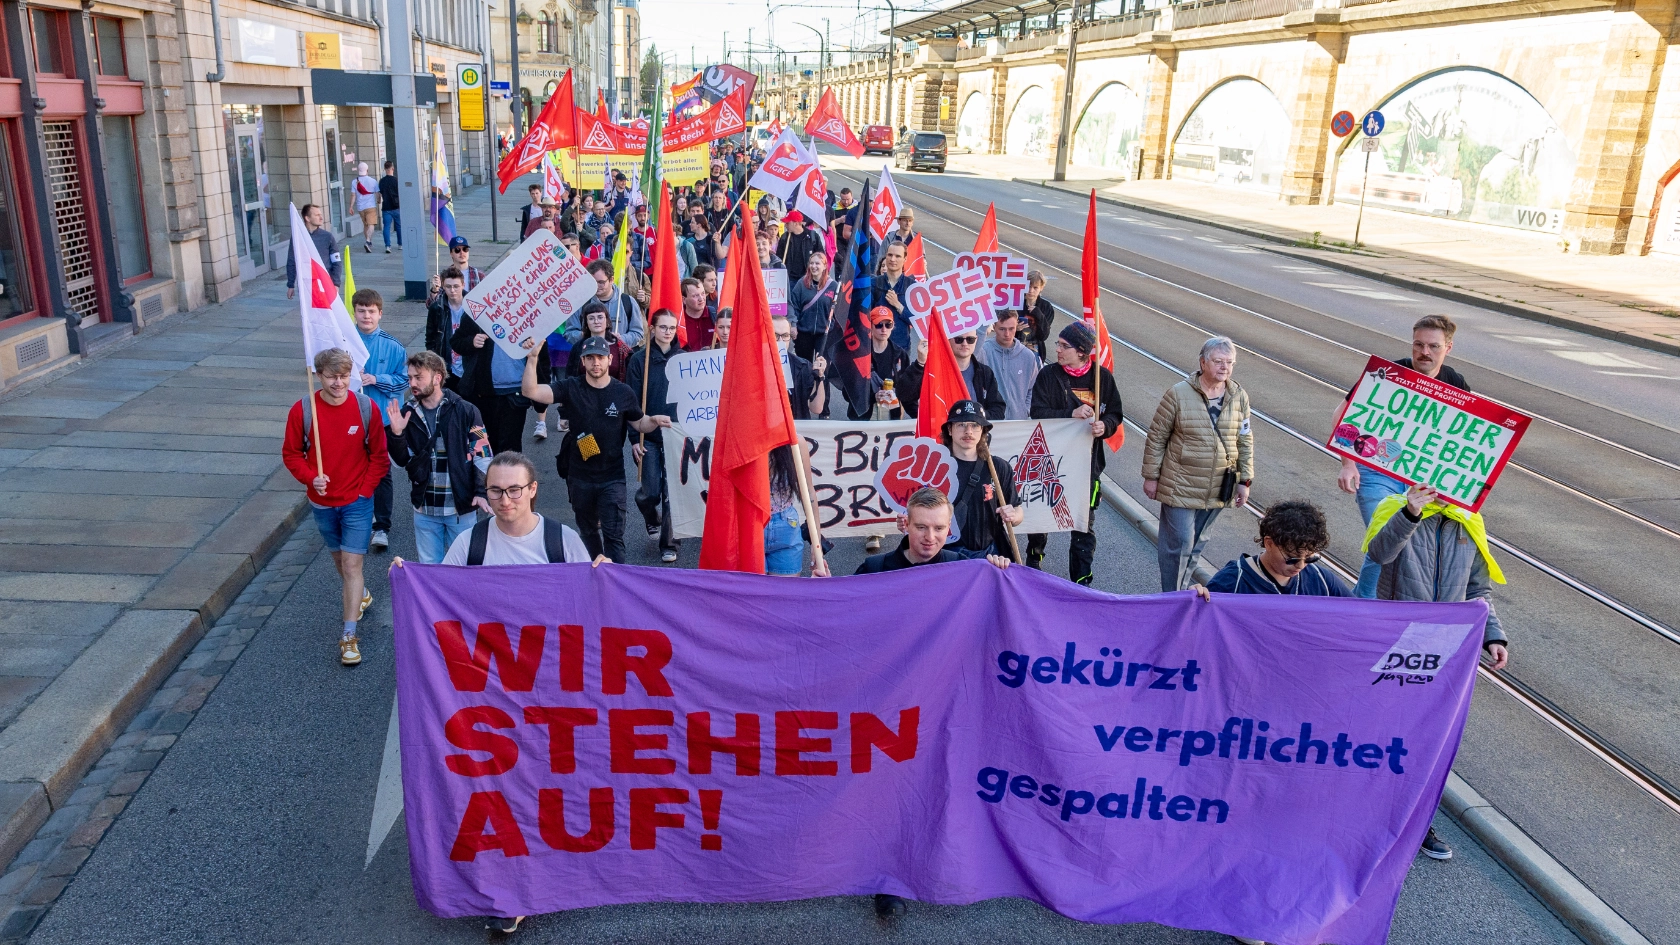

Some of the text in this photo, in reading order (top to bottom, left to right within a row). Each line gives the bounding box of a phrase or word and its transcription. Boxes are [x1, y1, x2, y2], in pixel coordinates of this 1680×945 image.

[680, 127, 705, 142] Recht
[769, 163, 793, 178] IGBCE
[1517, 209, 1547, 228] VVO
[520, 260, 534, 273] von
[531, 239, 554, 261] UNS
[485, 308, 504, 323] hat
[525, 255, 554, 285] einen
[503, 255, 576, 327] Bundeskanzler
[909, 272, 984, 313] OST=
[508, 308, 541, 344] ertragen
[678, 355, 727, 380] HÄN
[1395, 376, 1415, 388] STATT
[1416, 384, 1433, 395] EURE
[1416, 378, 1477, 403] UNSERE ZUKUNFT
[1343, 401, 1496, 477] ZUM LEBEN
[1446, 411, 1502, 449] DER
[1392, 449, 1492, 504] REICHT
[434, 619, 675, 697] WIR
[996, 642, 1201, 691] gekürzt
[1381, 653, 1441, 670] DGB
[444, 705, 920, 777] STEHEN
[1094, 717, 1408, 774] verpflichtet
[976, 765, 1230, 823] gespalten
[450, 786, 723, 862] AUF!
